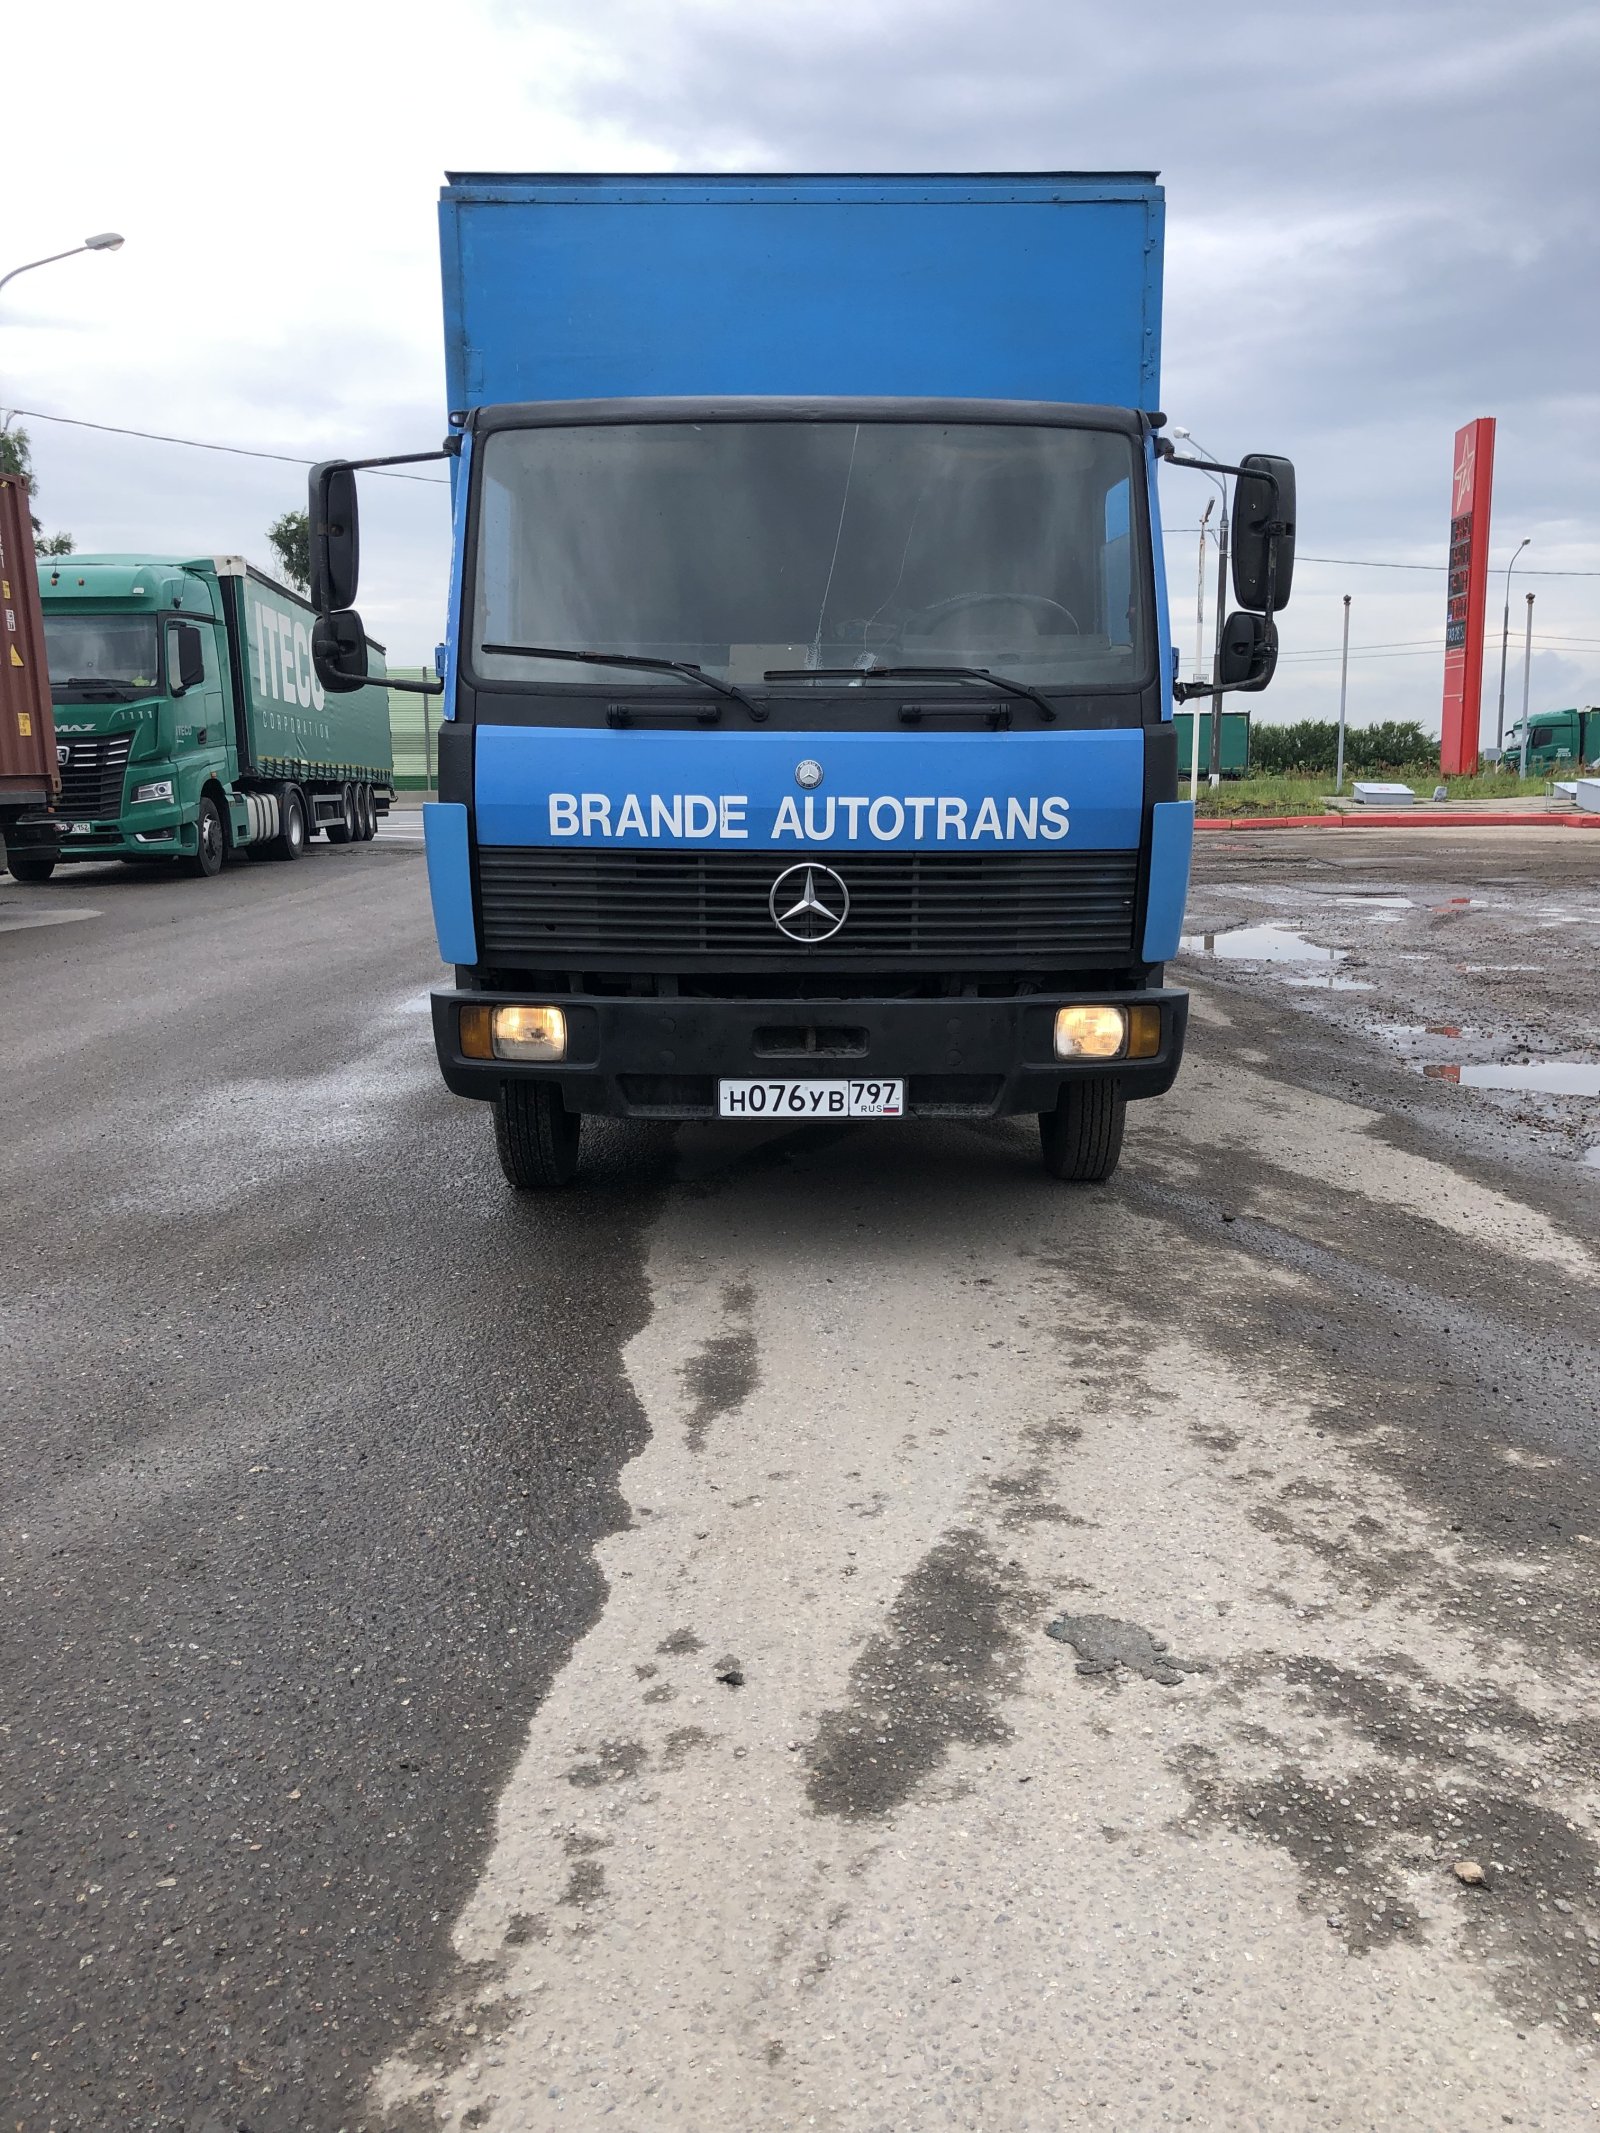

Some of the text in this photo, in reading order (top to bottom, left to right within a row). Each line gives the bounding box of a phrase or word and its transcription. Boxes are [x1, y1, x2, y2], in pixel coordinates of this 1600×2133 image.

[262, 710, 330, 739] CORPORATION
[548, 792, 1071, 841] BRANDE AUTOTRANS
[851, 1082, 896, 1105] 797
[860, 1104, 883, 1113] RUS
